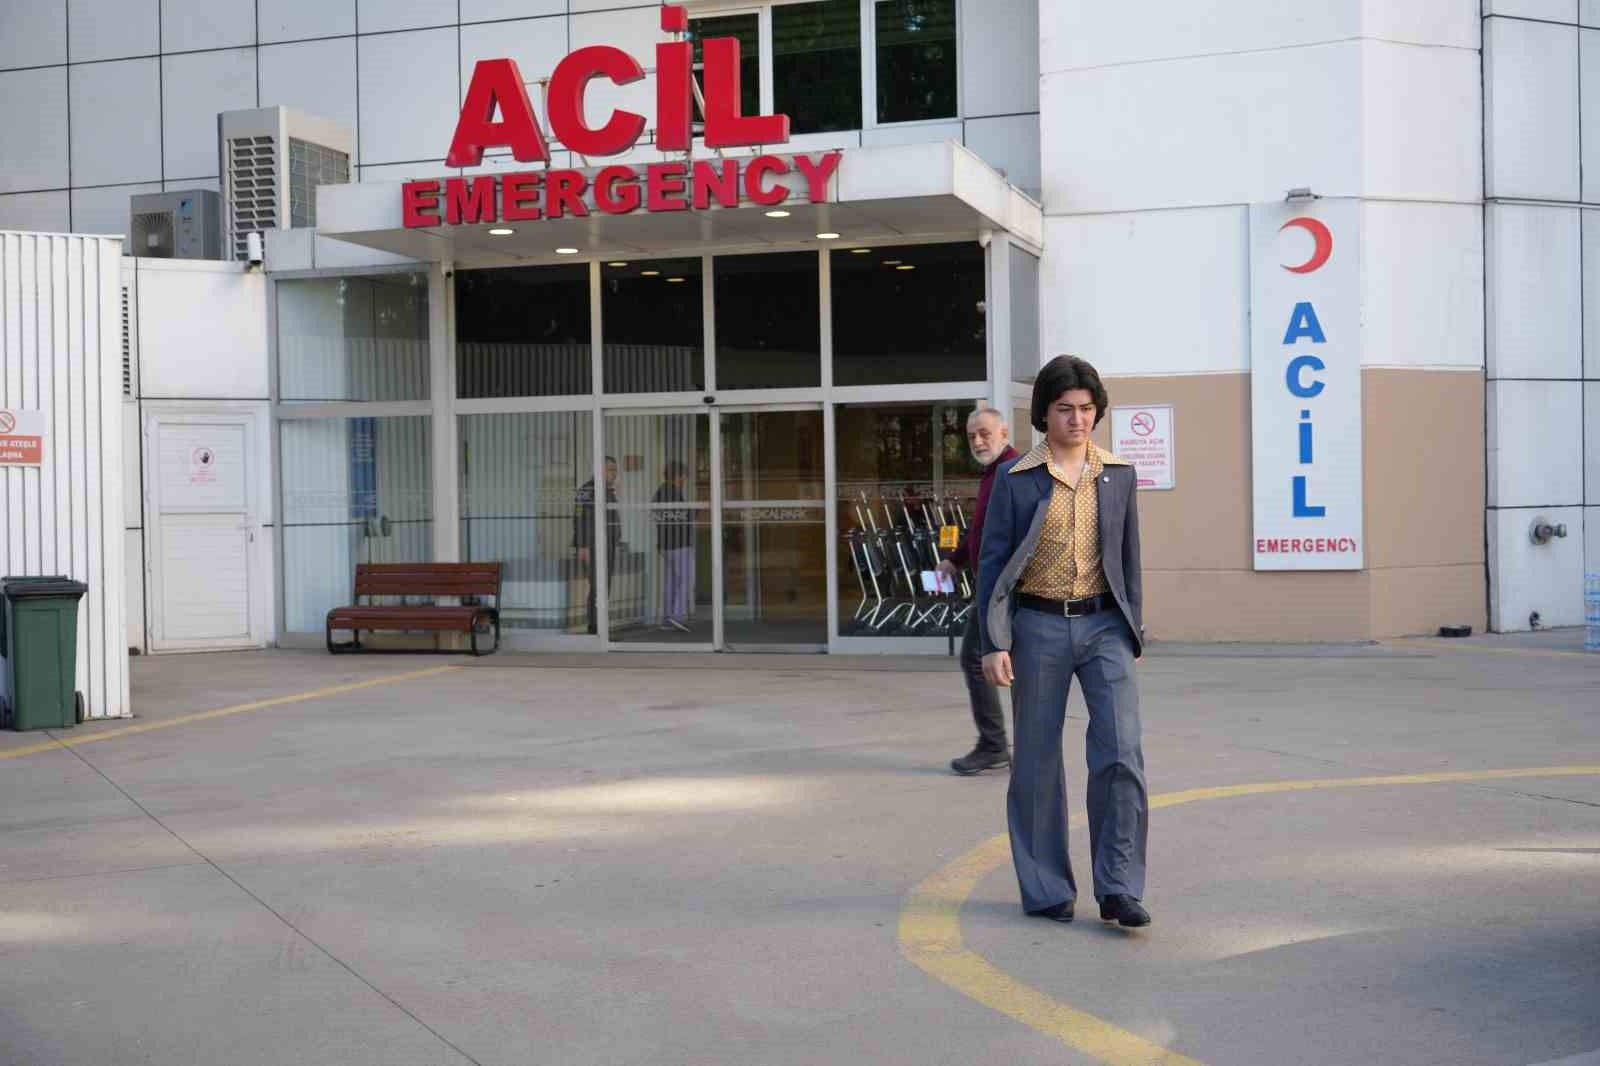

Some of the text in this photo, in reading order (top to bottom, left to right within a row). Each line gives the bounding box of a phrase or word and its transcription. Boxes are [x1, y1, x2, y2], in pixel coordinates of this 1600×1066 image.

[445, 5, 790, 168] ACİL
[402, 152, 842, 228] EMERGENCY
[1283, 301, 1327, 518] ACİL
[1256, 538, 1357, 553] EMERGENCY
